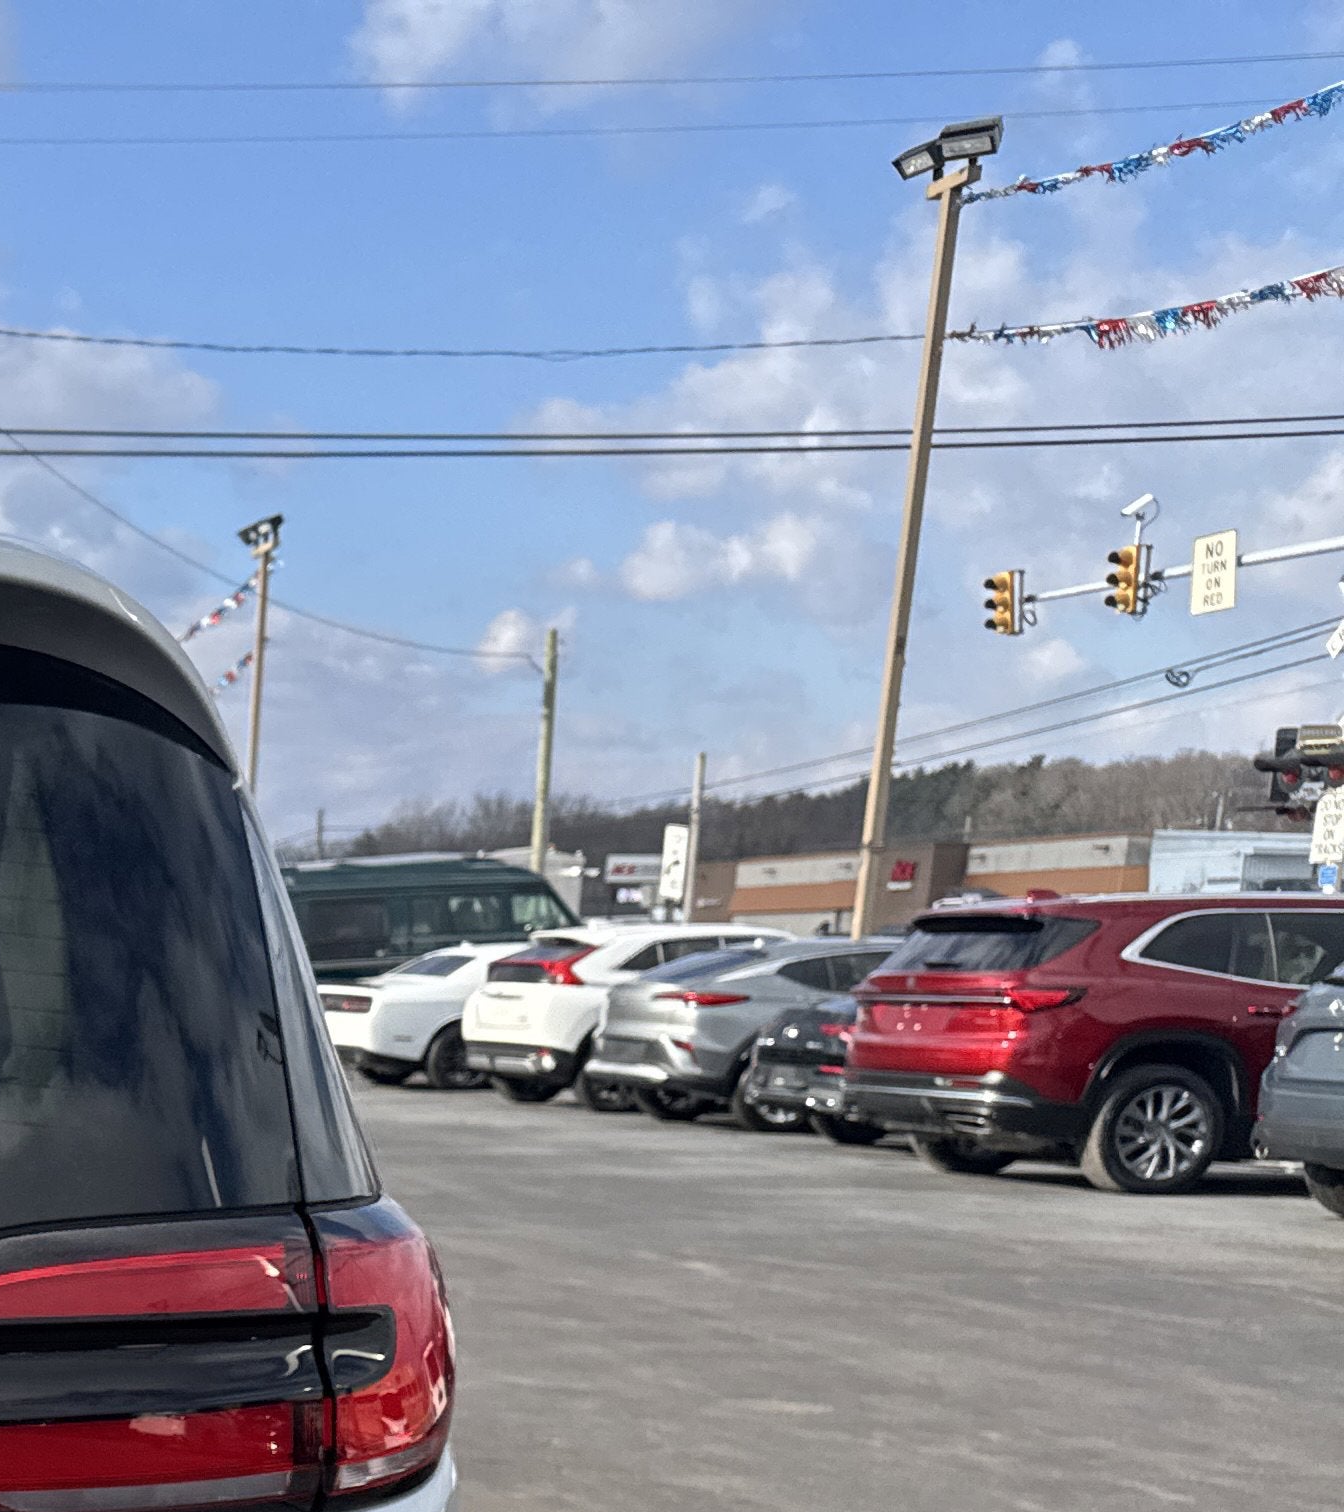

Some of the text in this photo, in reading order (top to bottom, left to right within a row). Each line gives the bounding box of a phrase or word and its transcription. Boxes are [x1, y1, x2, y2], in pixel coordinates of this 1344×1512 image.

[1205, 540, 1224, 560] NO
[1201, 559, 1228, 575] TURN
[1205, 577, 1221, 591] ON
[1203, 592, 1224, 607] RED
